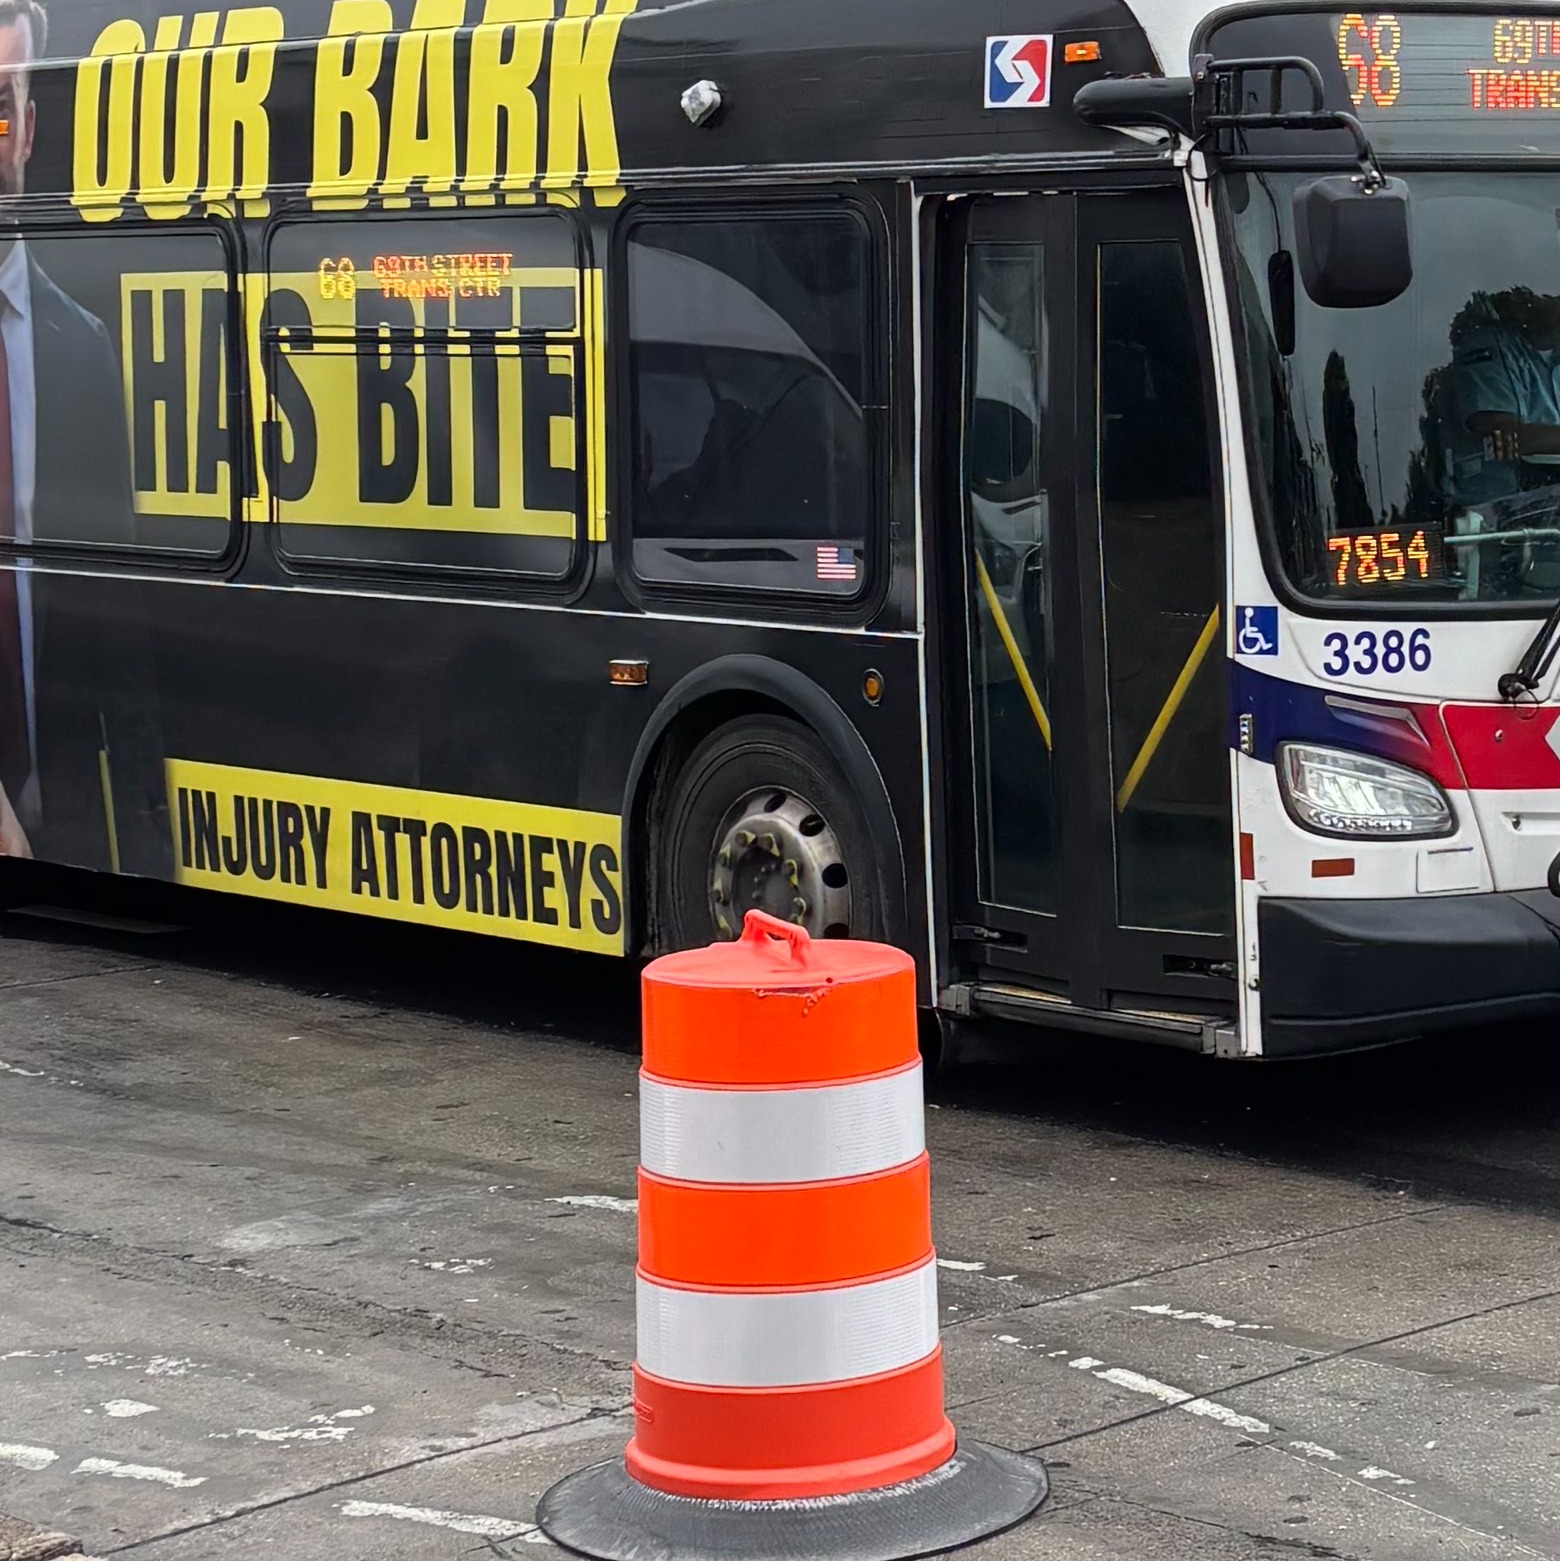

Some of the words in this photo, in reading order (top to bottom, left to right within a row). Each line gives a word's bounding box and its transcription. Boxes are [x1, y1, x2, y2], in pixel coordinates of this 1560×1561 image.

[71, 6, 285, 222] OUR
[372, 255, 429, 278] 69TH
[431, 253, 514, 277] STREET
[379, 278, 452, 300] TRANS
[458, 276, 501, 298] CTR
[131, 286, 318, 502] HAS
[355, 286, 577, 513] BITE
[1328, 530, 1429, 586] 7854
[1323, 627, 1432, 677] 3386
[177, 786, 331, 889] INJURY
[351, 811, 622, 935] ATTORNEYS
